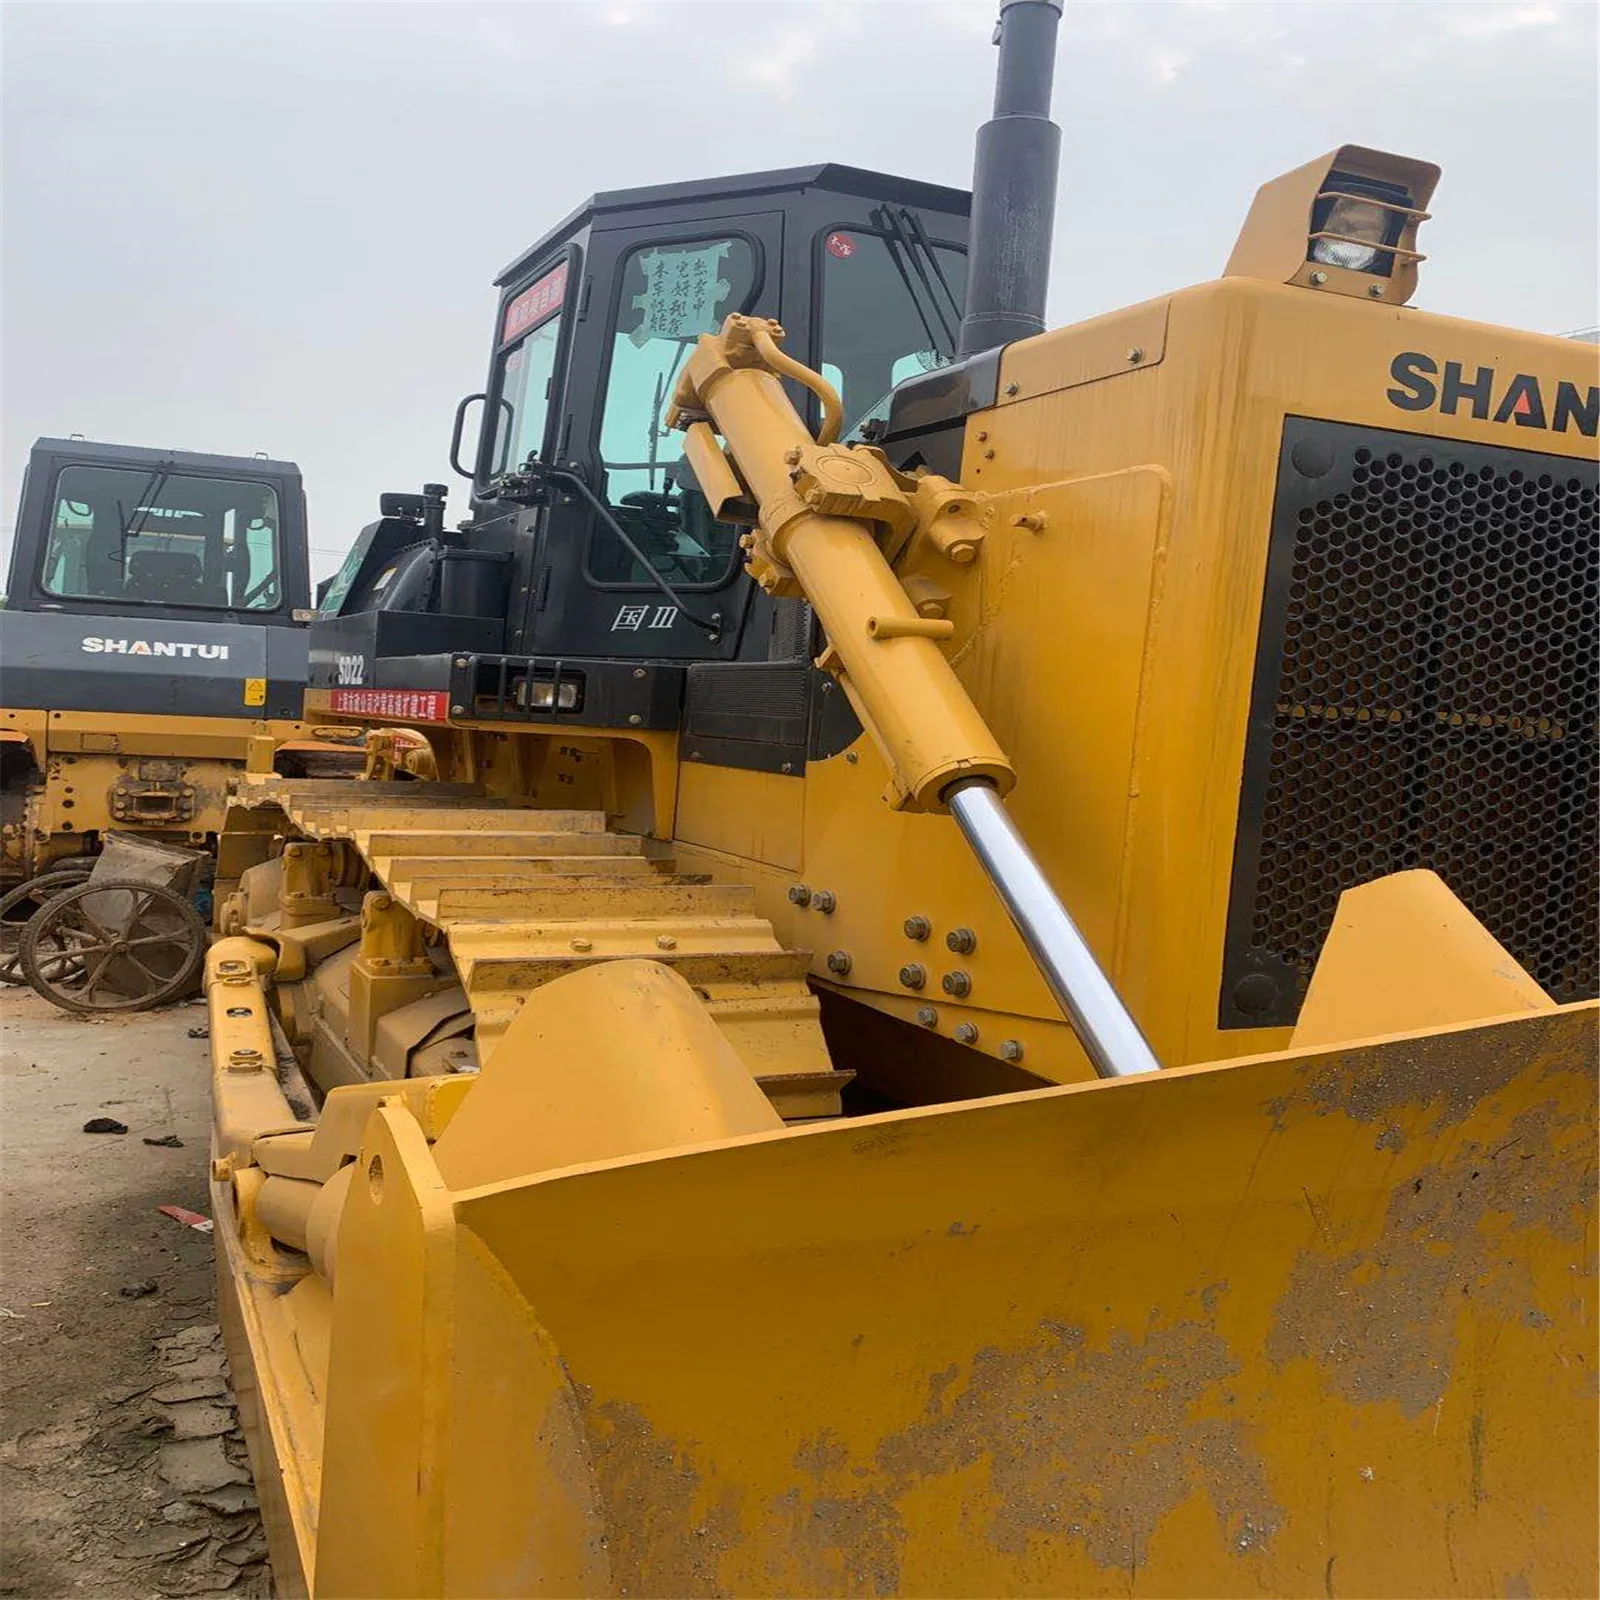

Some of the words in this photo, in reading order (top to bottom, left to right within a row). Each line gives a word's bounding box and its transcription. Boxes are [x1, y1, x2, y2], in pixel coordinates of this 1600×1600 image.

[1386, 351, 1600, 438] SHAN
[81, 637, 229, 660] SHANTUI
[338, 655, 365, 685] SD22
